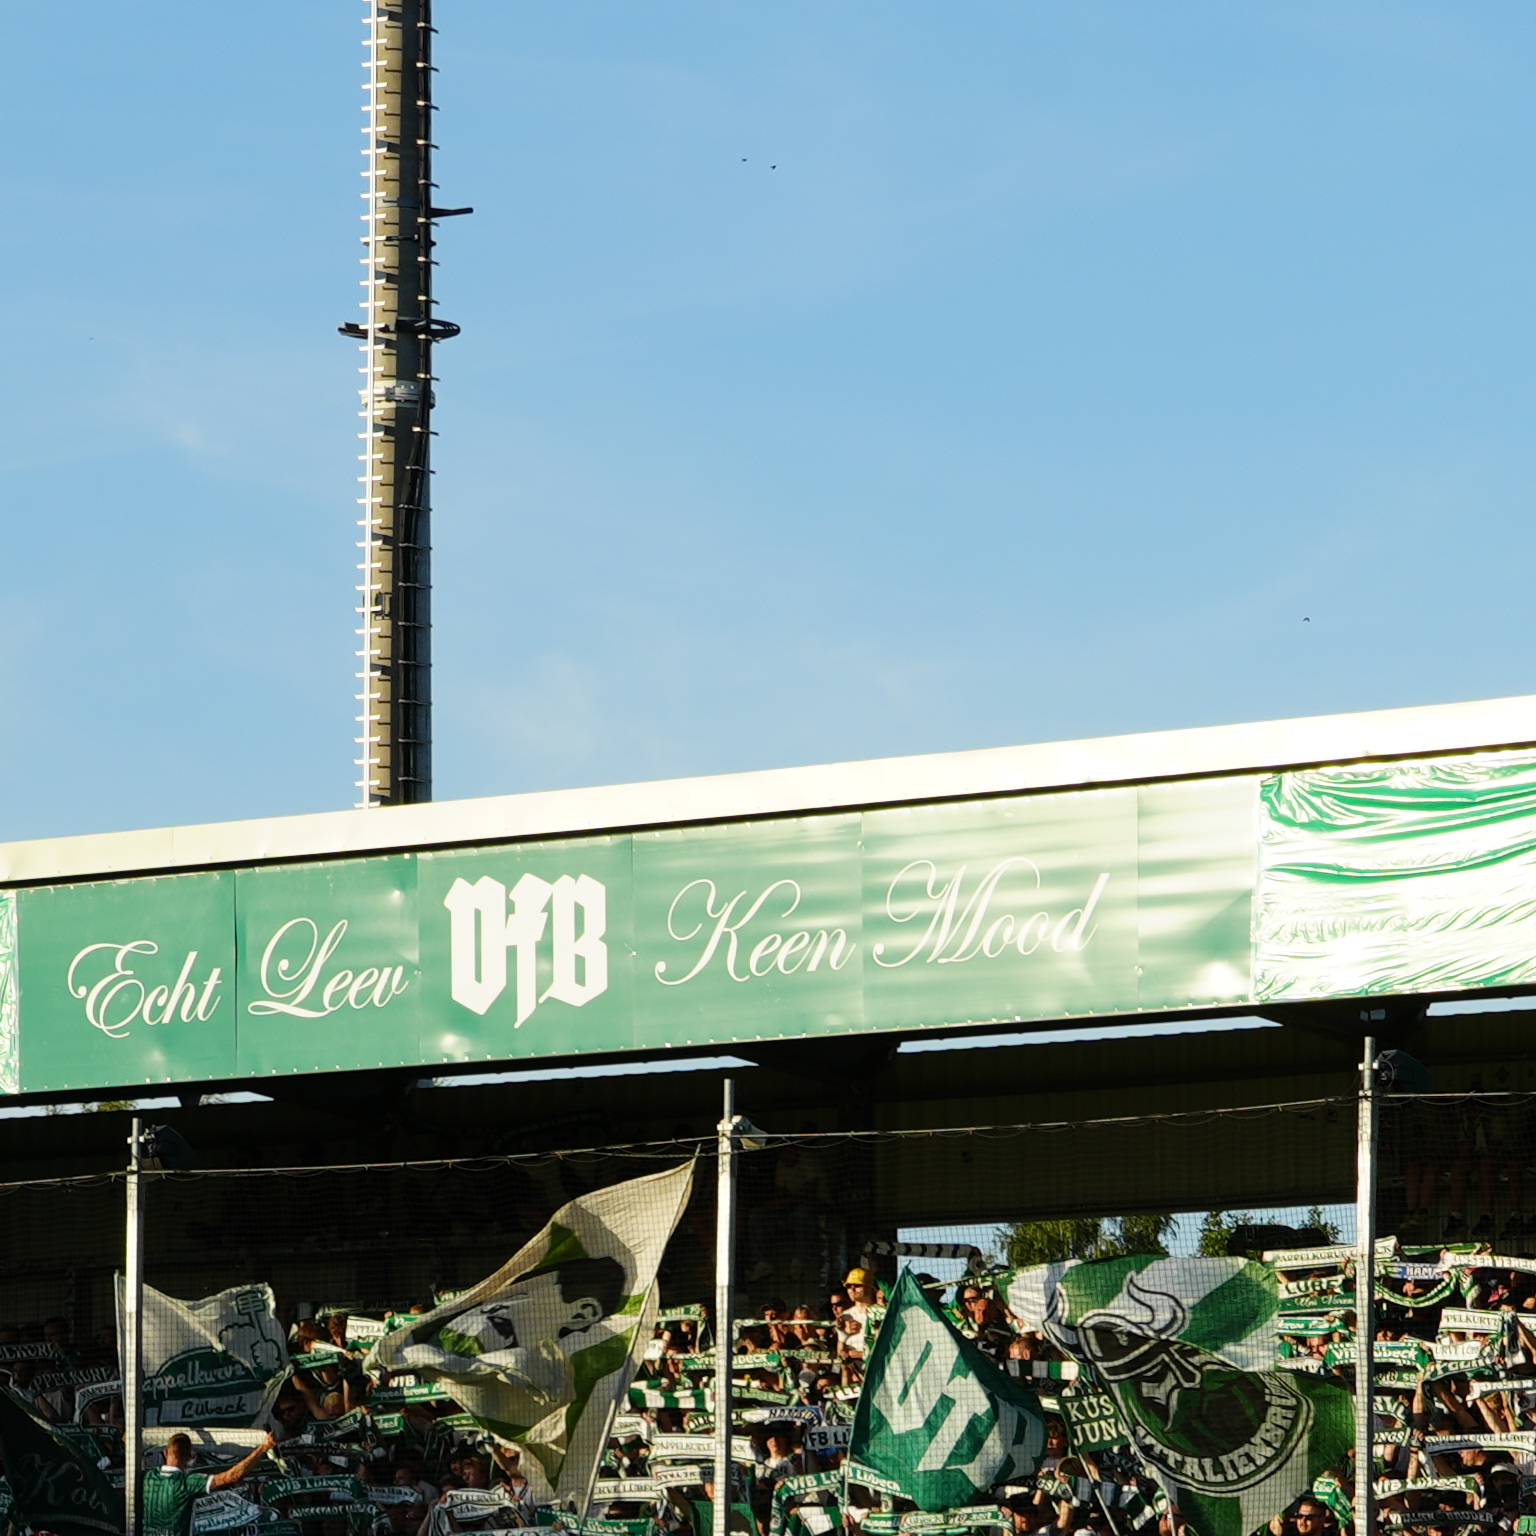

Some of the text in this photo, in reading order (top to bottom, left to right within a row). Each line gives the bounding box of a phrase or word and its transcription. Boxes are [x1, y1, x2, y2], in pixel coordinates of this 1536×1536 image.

[68, 940, 221, 1039] Echt
[655, 878, 855, 986] Keen
[873, 858, 1110, 971] Mood
